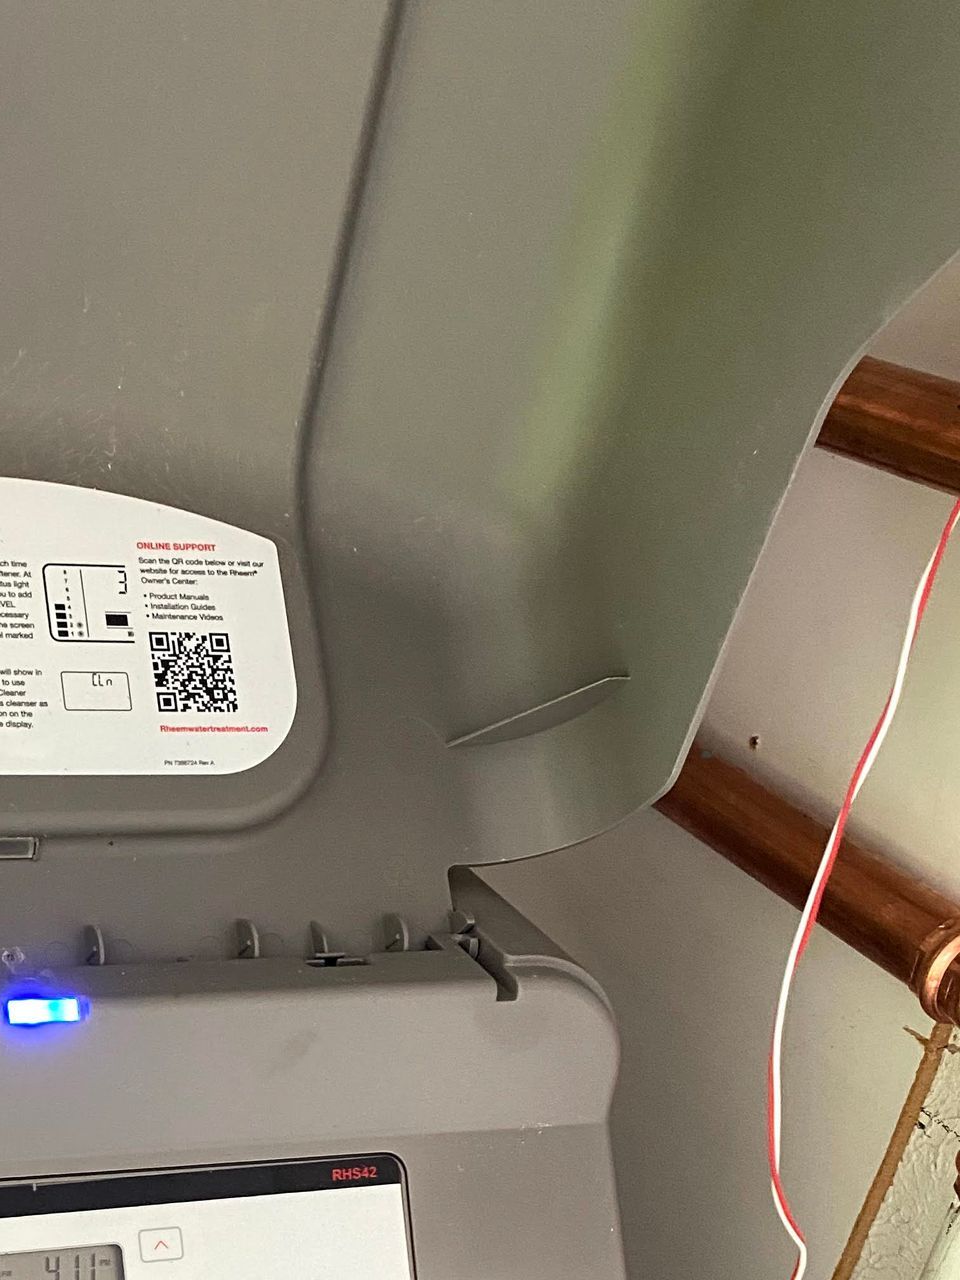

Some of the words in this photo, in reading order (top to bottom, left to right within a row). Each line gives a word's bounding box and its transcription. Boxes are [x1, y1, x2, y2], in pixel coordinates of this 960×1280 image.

[136, 542, 170, 550] ONLINE
[172, 542, 215, 551] SUPPORT
[138, 556, 157, 564] Scan
[171, 557, 184, 565] QR
[13, 580, 29, 589] light
[148, 592, 177, 600] Product
[150, 602, 189, 610] Installation
[151, 612, 197, 620] Maintenance
[92, 672, 112, 686] CLn
[332, 1166, 377, 1181] RHS42
